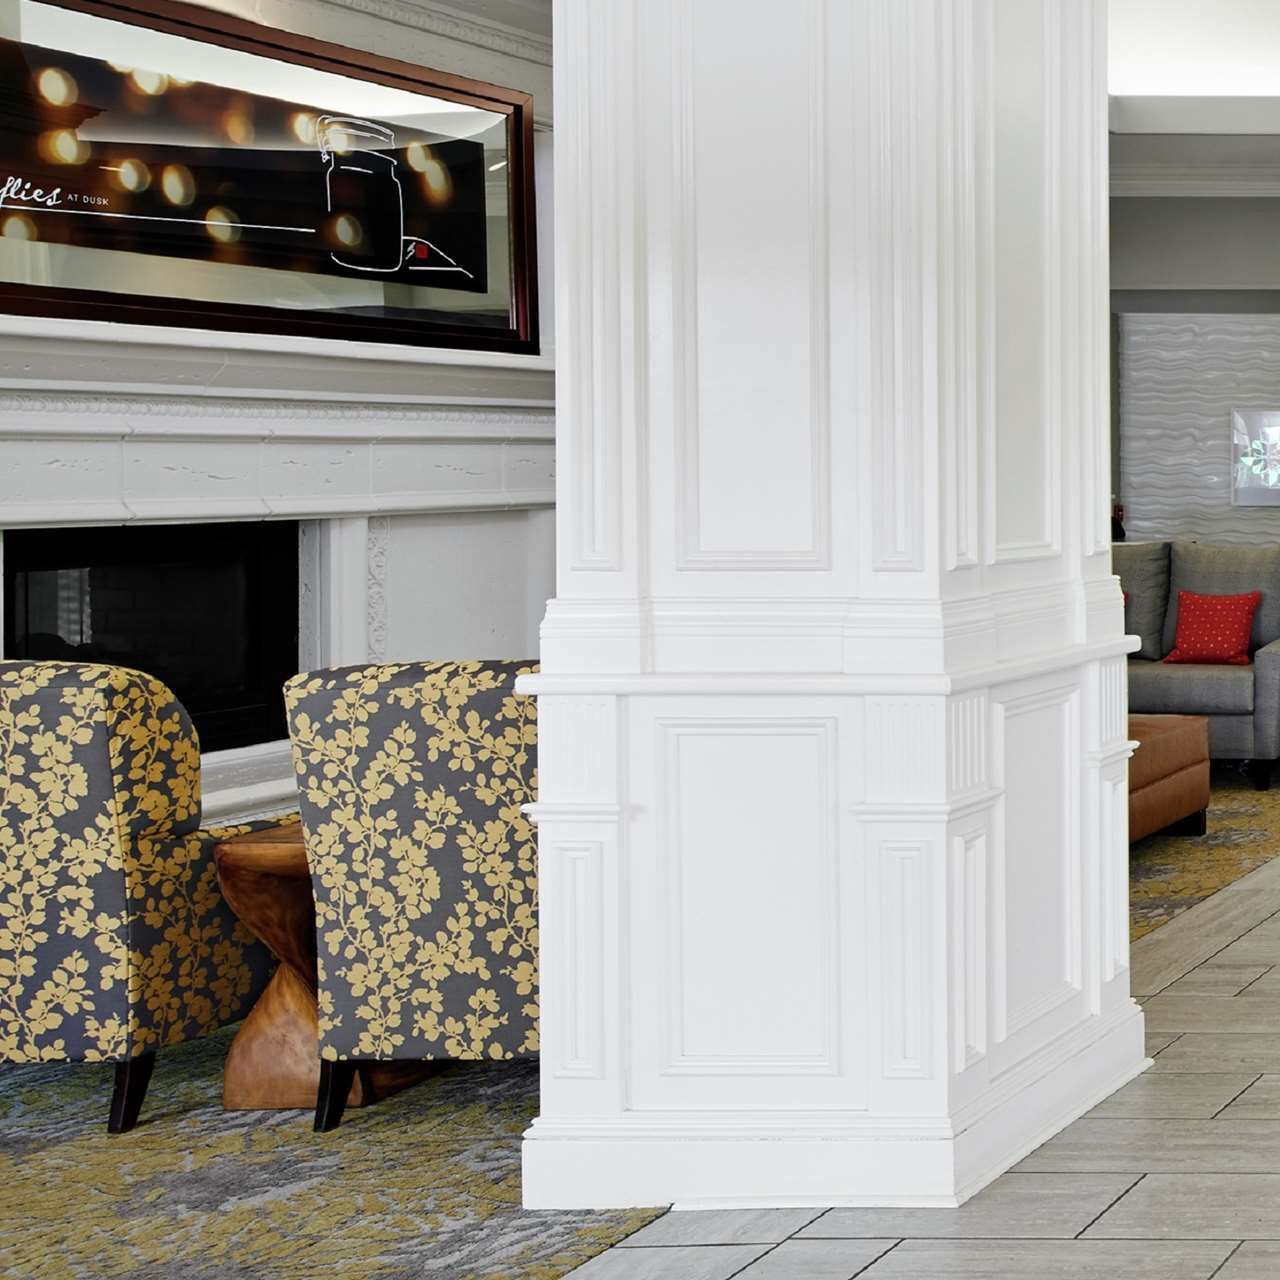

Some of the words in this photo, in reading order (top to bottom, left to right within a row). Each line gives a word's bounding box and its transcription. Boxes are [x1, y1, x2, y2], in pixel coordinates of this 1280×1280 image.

[0, 176, 62, 207] flies
[67, 193, 79, 202] AT
[83, 195, 109, 206] DUSK
